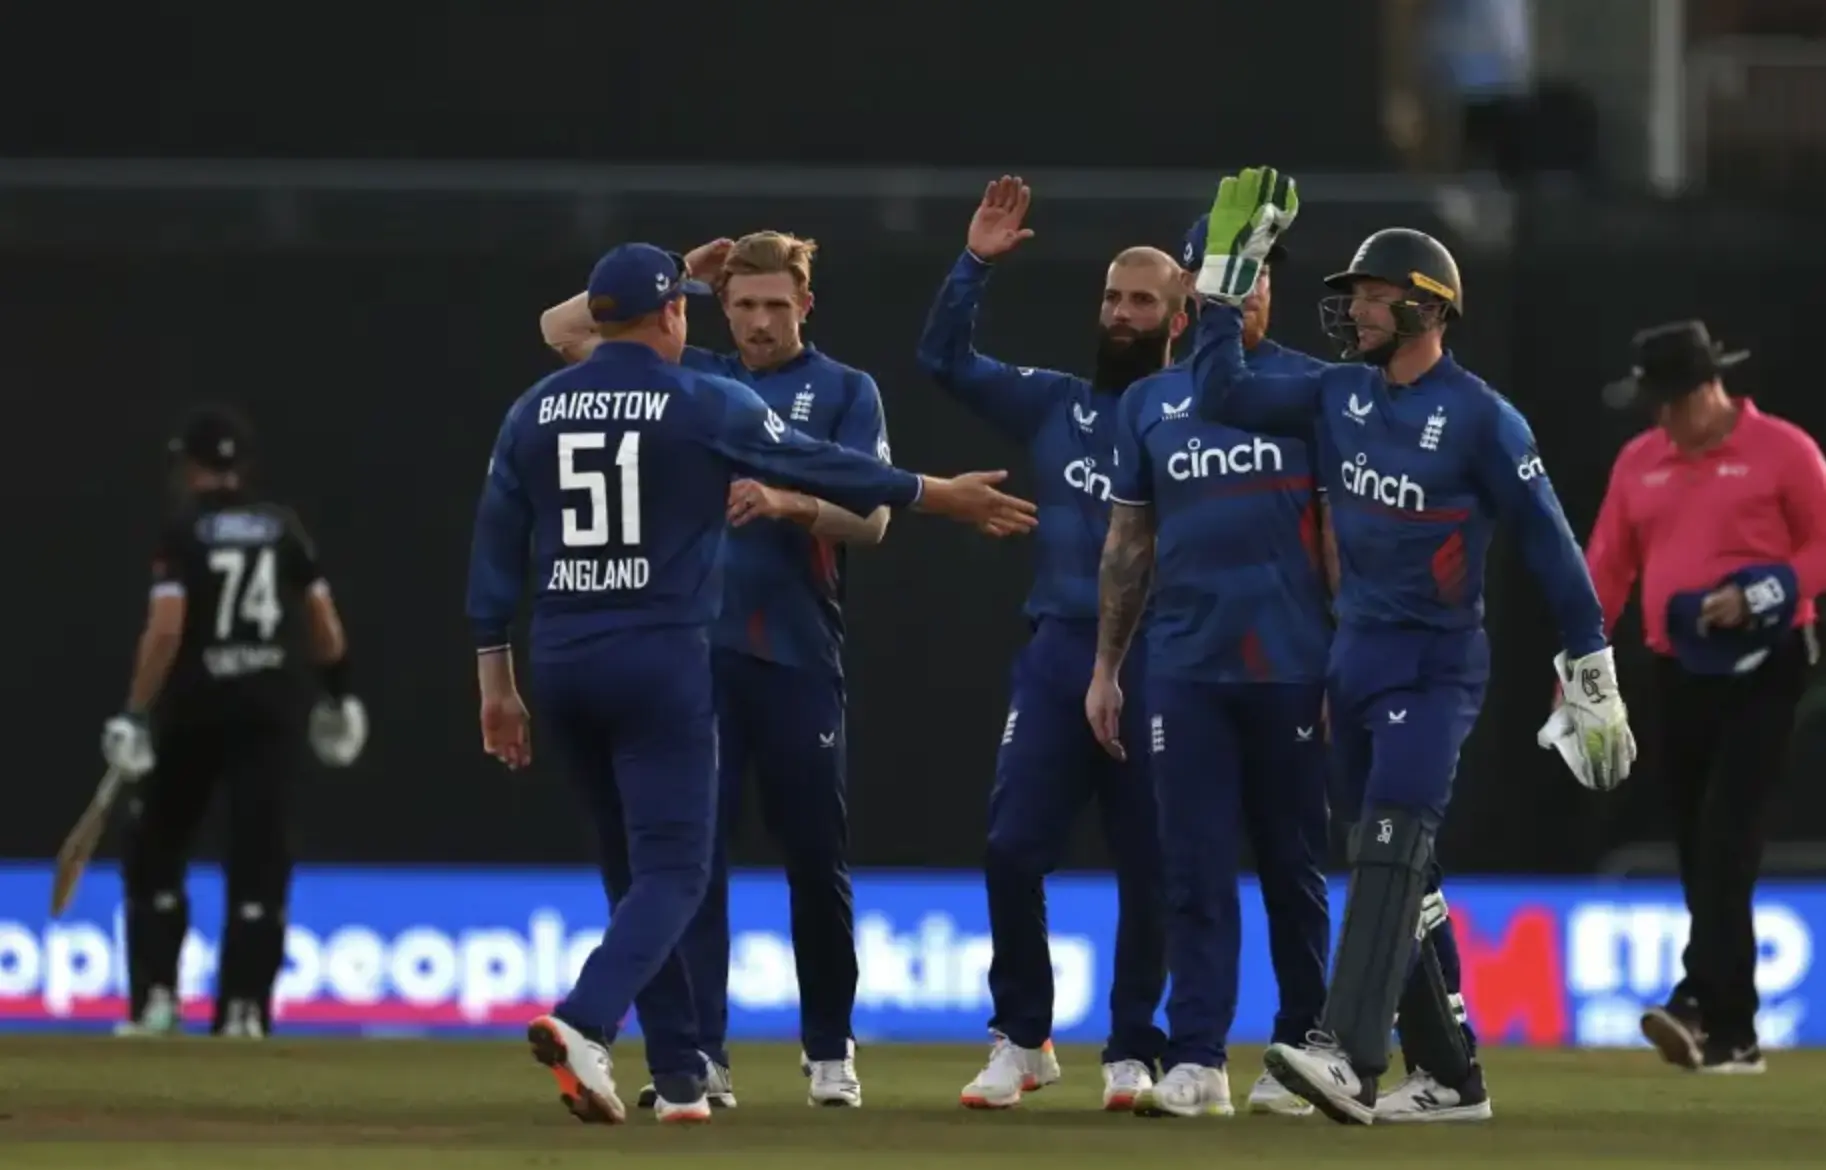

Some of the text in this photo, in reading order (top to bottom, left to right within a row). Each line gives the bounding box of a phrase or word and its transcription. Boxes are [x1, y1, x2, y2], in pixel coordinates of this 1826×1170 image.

[538, 391, 670, 425] BAIRSTOW
[1064, 456, 1112, 501] cin
[1167, 437, 1282, 481] cinch
[558, 431, 640, 546] 51
[1341, 452, 1425, 512] cinch
[208, 548, 281, 640] 74
[548, 557, 650, 591] ENGLAND
